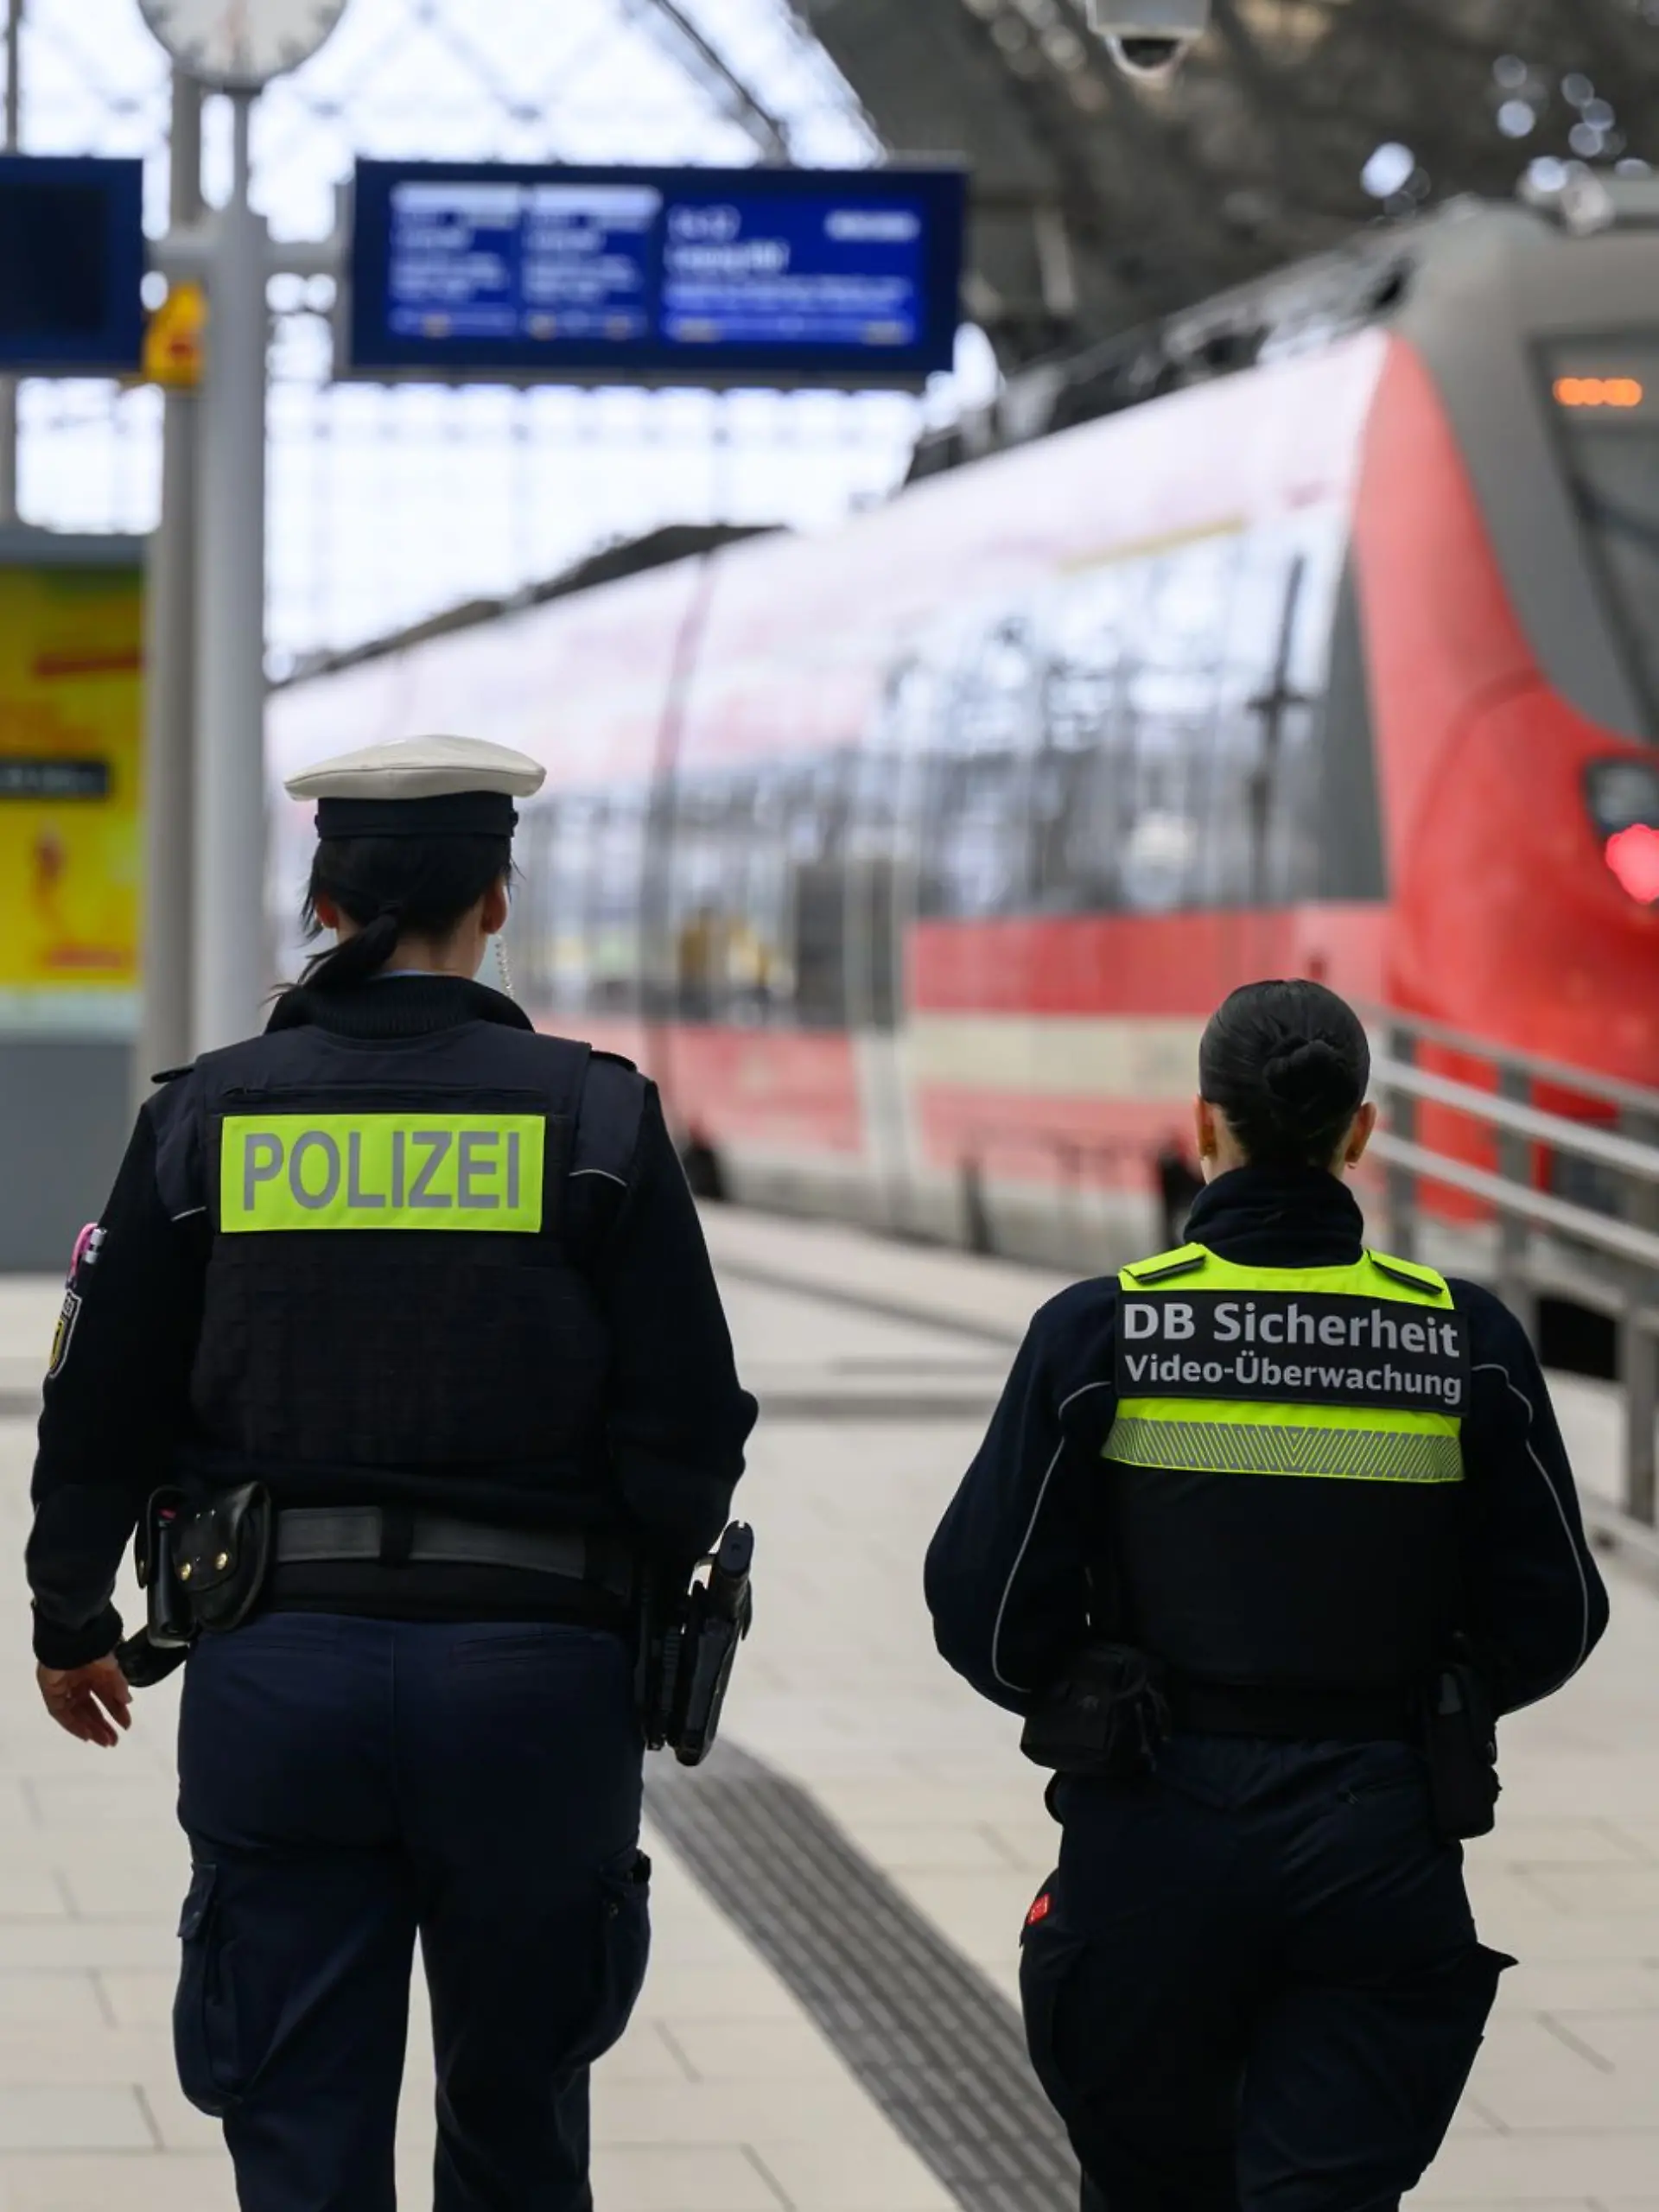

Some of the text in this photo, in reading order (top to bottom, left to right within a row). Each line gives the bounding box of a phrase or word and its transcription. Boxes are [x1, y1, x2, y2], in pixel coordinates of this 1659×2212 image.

[244, 1130, 520, 1211] POLIZEI
[1123, 1302, 1459, 1357] DB Sicherheit
[1124, 1350, 1462, 1405] Video-Überwachung
